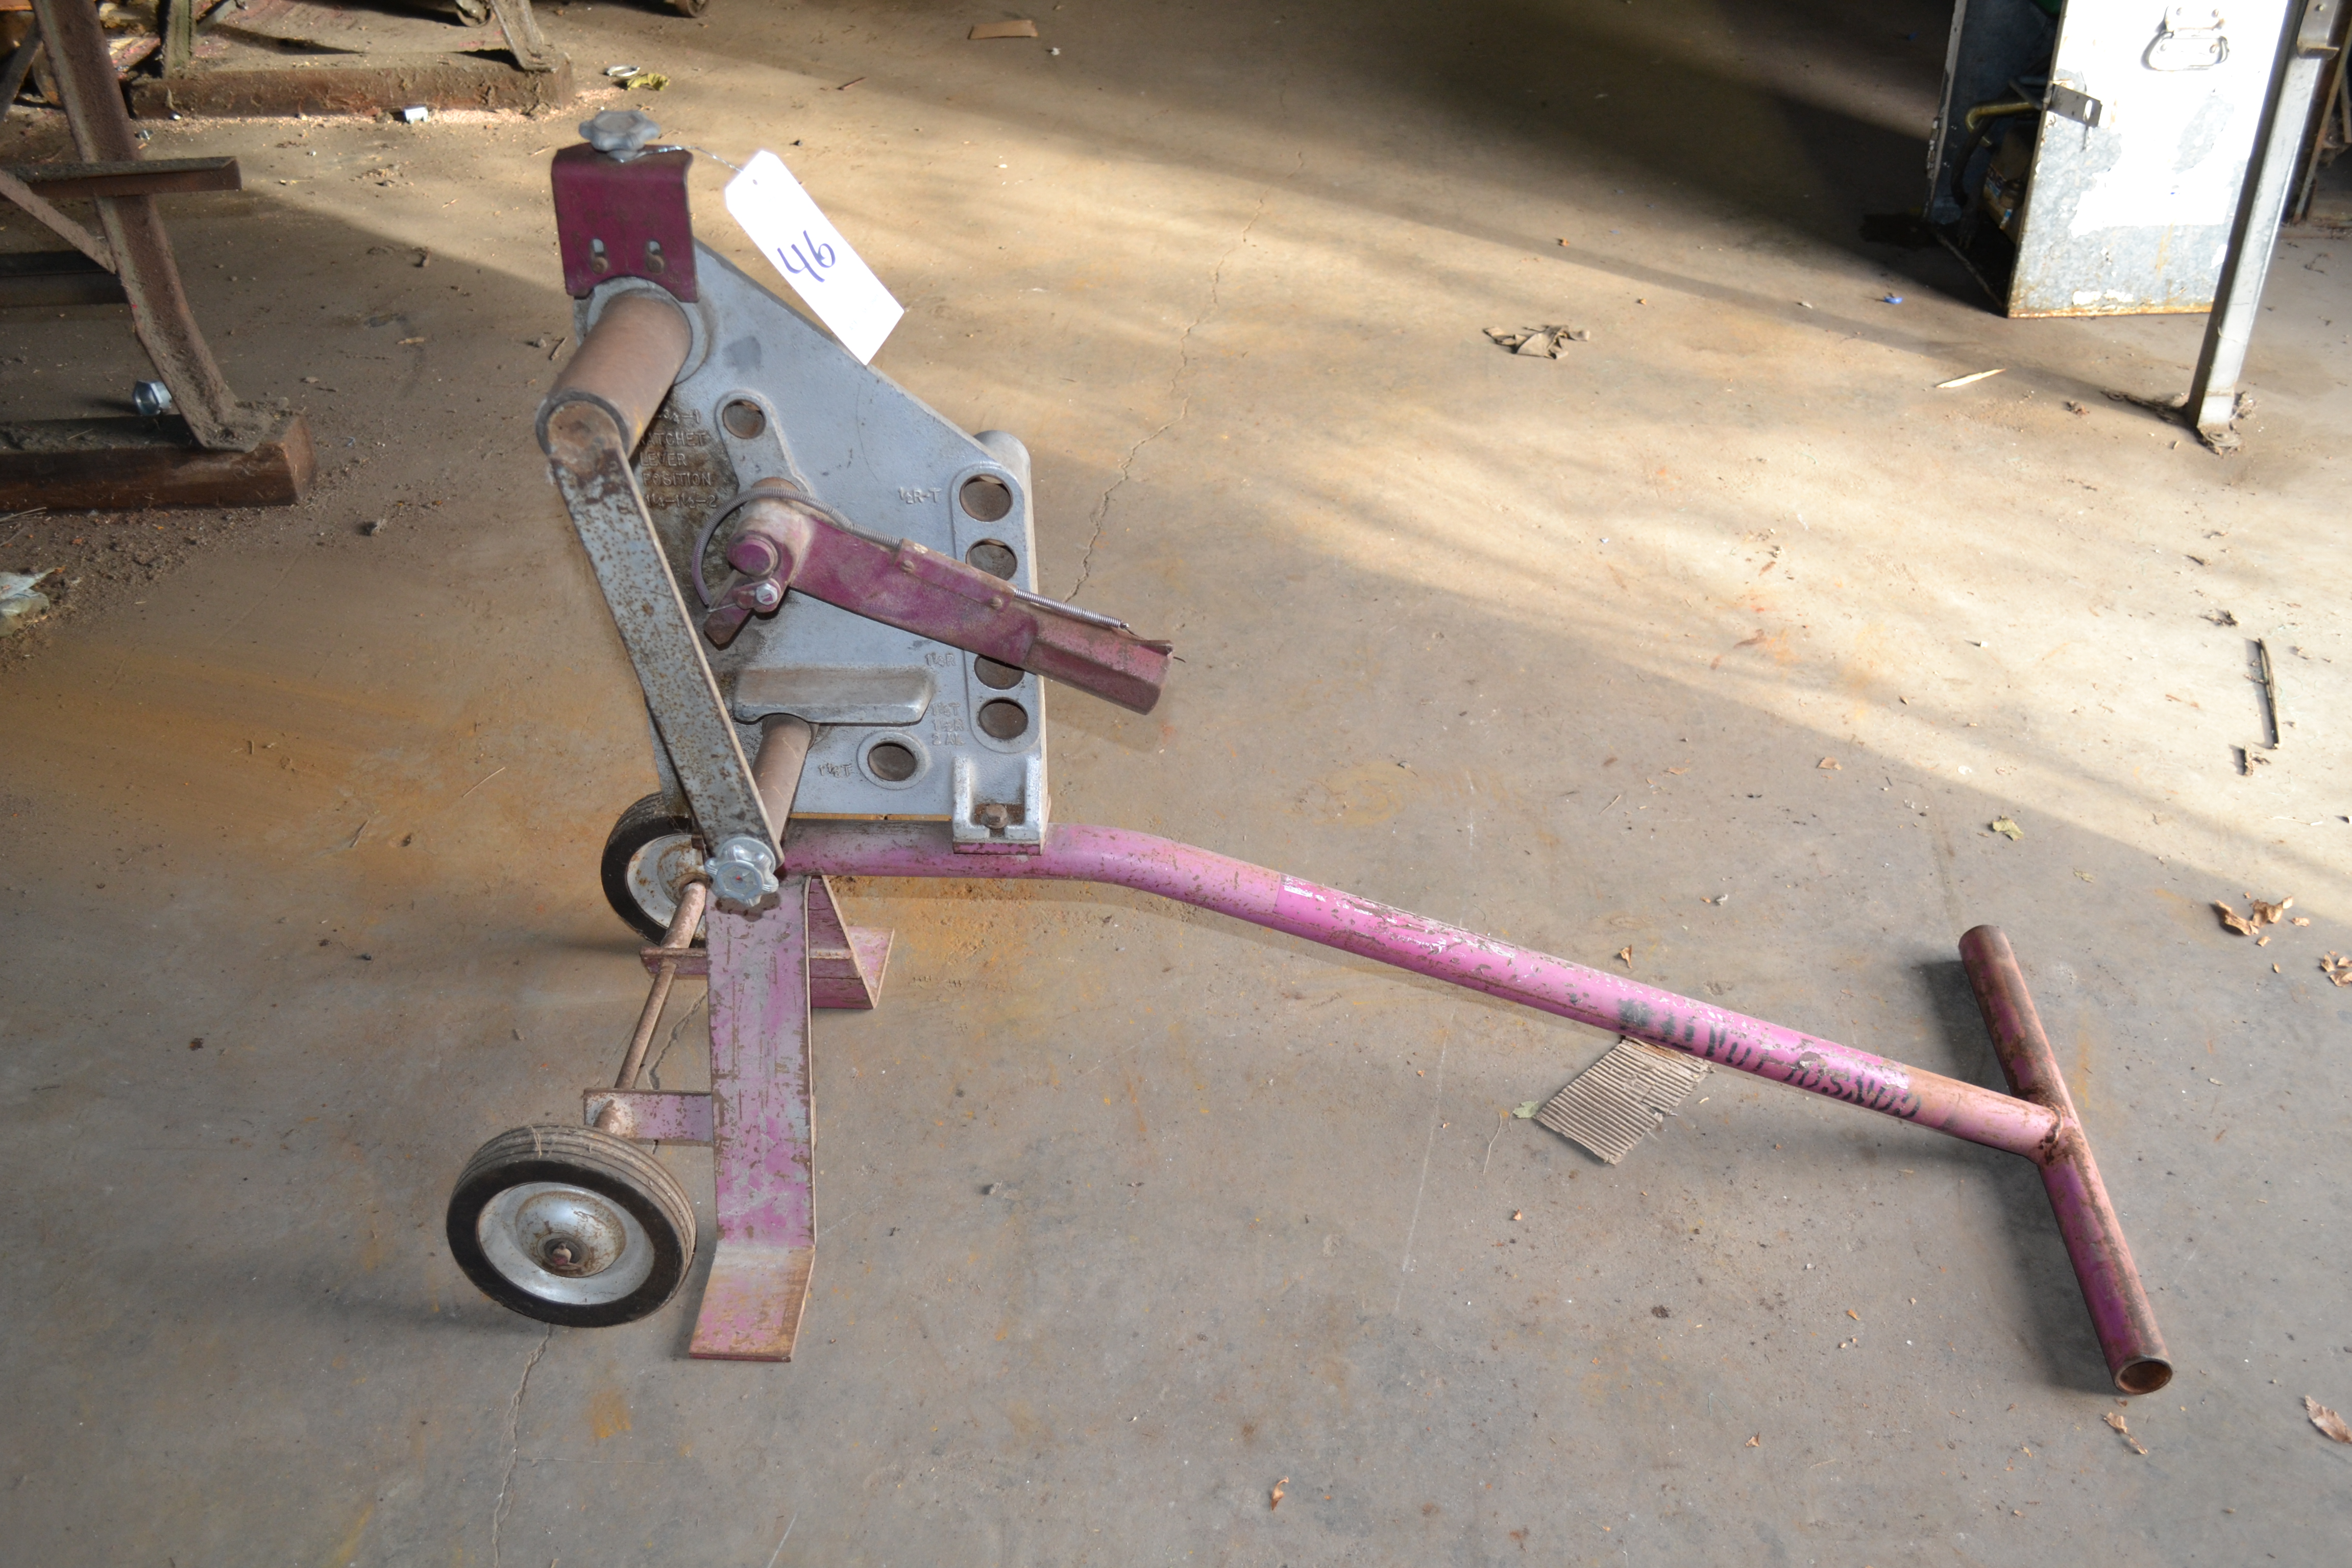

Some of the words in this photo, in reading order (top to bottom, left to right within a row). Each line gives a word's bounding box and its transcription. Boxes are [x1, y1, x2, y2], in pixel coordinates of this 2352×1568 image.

[777, 230, 836, 283] 46
[640, 452, 687, 467] LEVER
[642, 472, 712, 486] POSITION
[932, 733, 942, 746] 2
